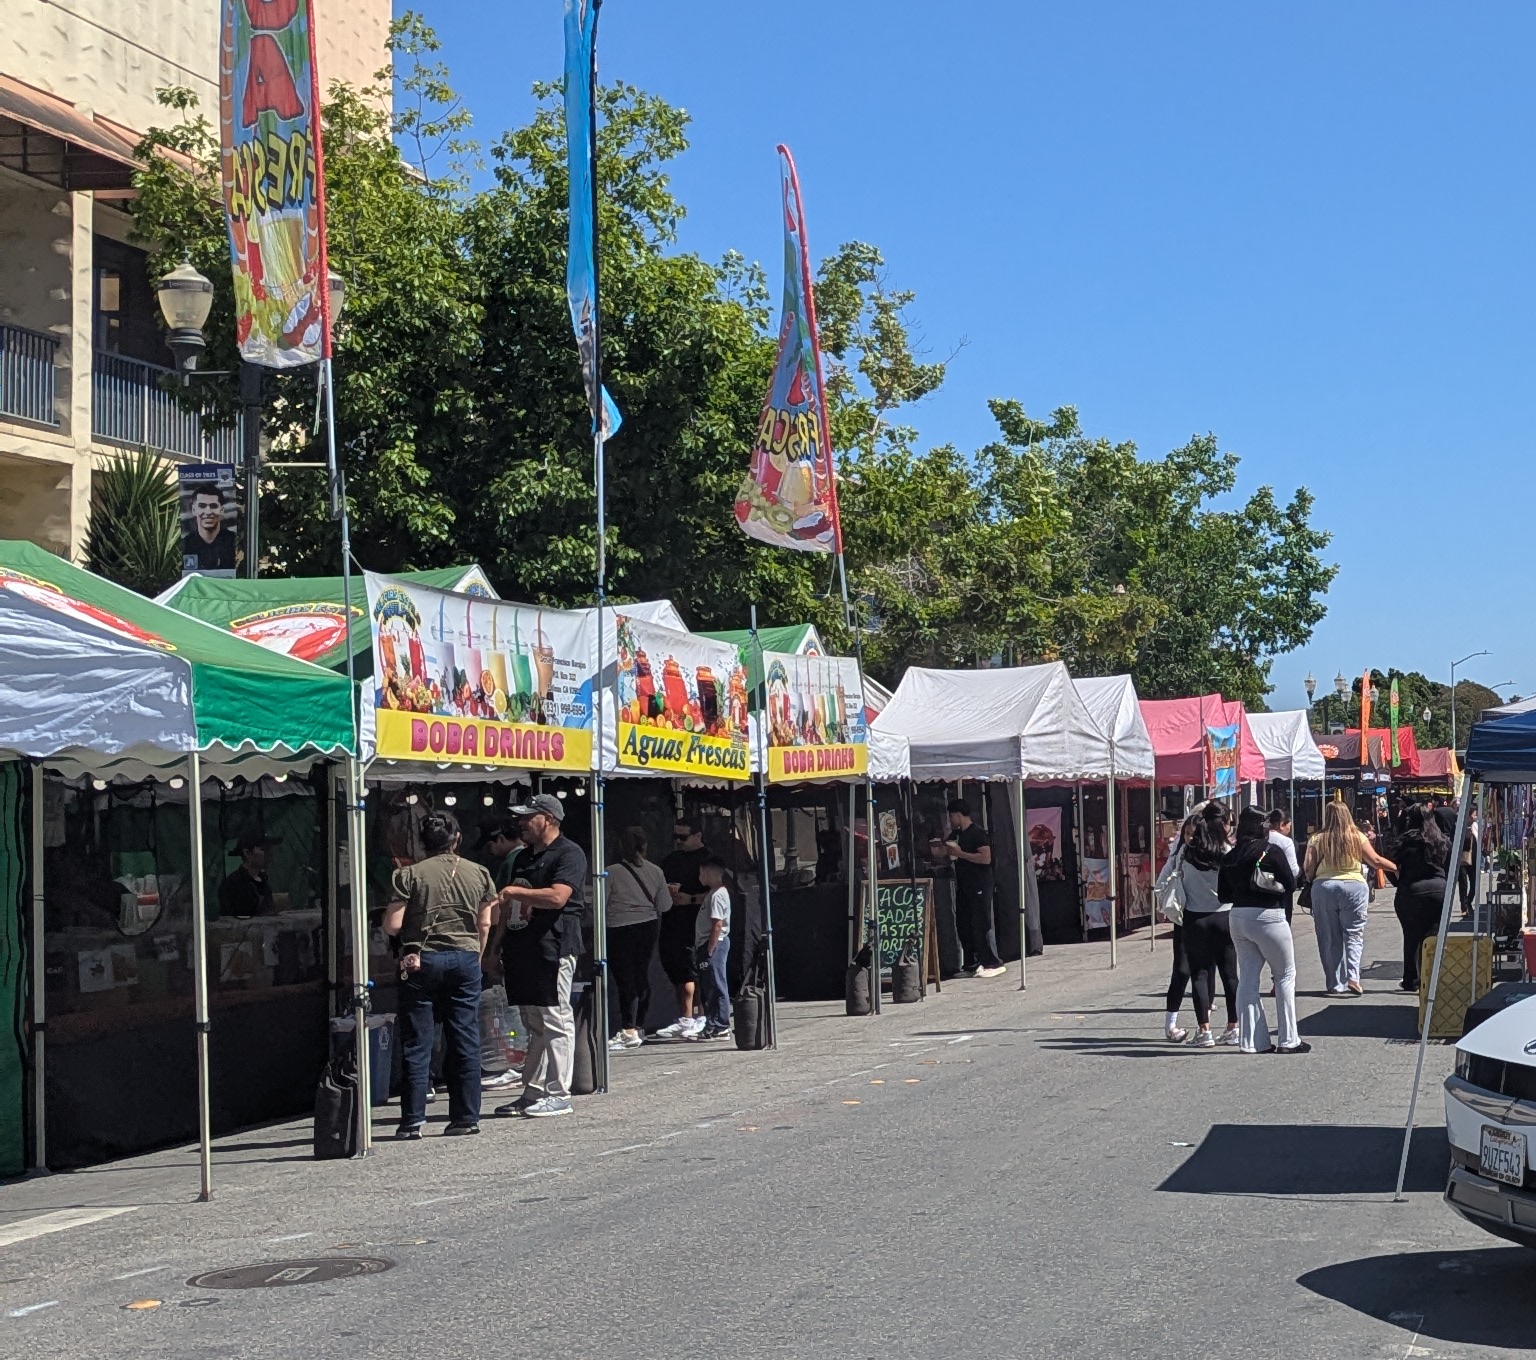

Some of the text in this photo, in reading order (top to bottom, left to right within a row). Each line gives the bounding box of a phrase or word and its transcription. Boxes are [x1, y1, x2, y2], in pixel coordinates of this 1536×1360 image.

[411, 718, 479, 757] BOBA
[622, 726, 684, 766] Aguas
[686, 735, 746, 771] Frescas
[783, 749, 815, 775] BOBA
[1482, 1144, 1521, 1177] 9UZF543
